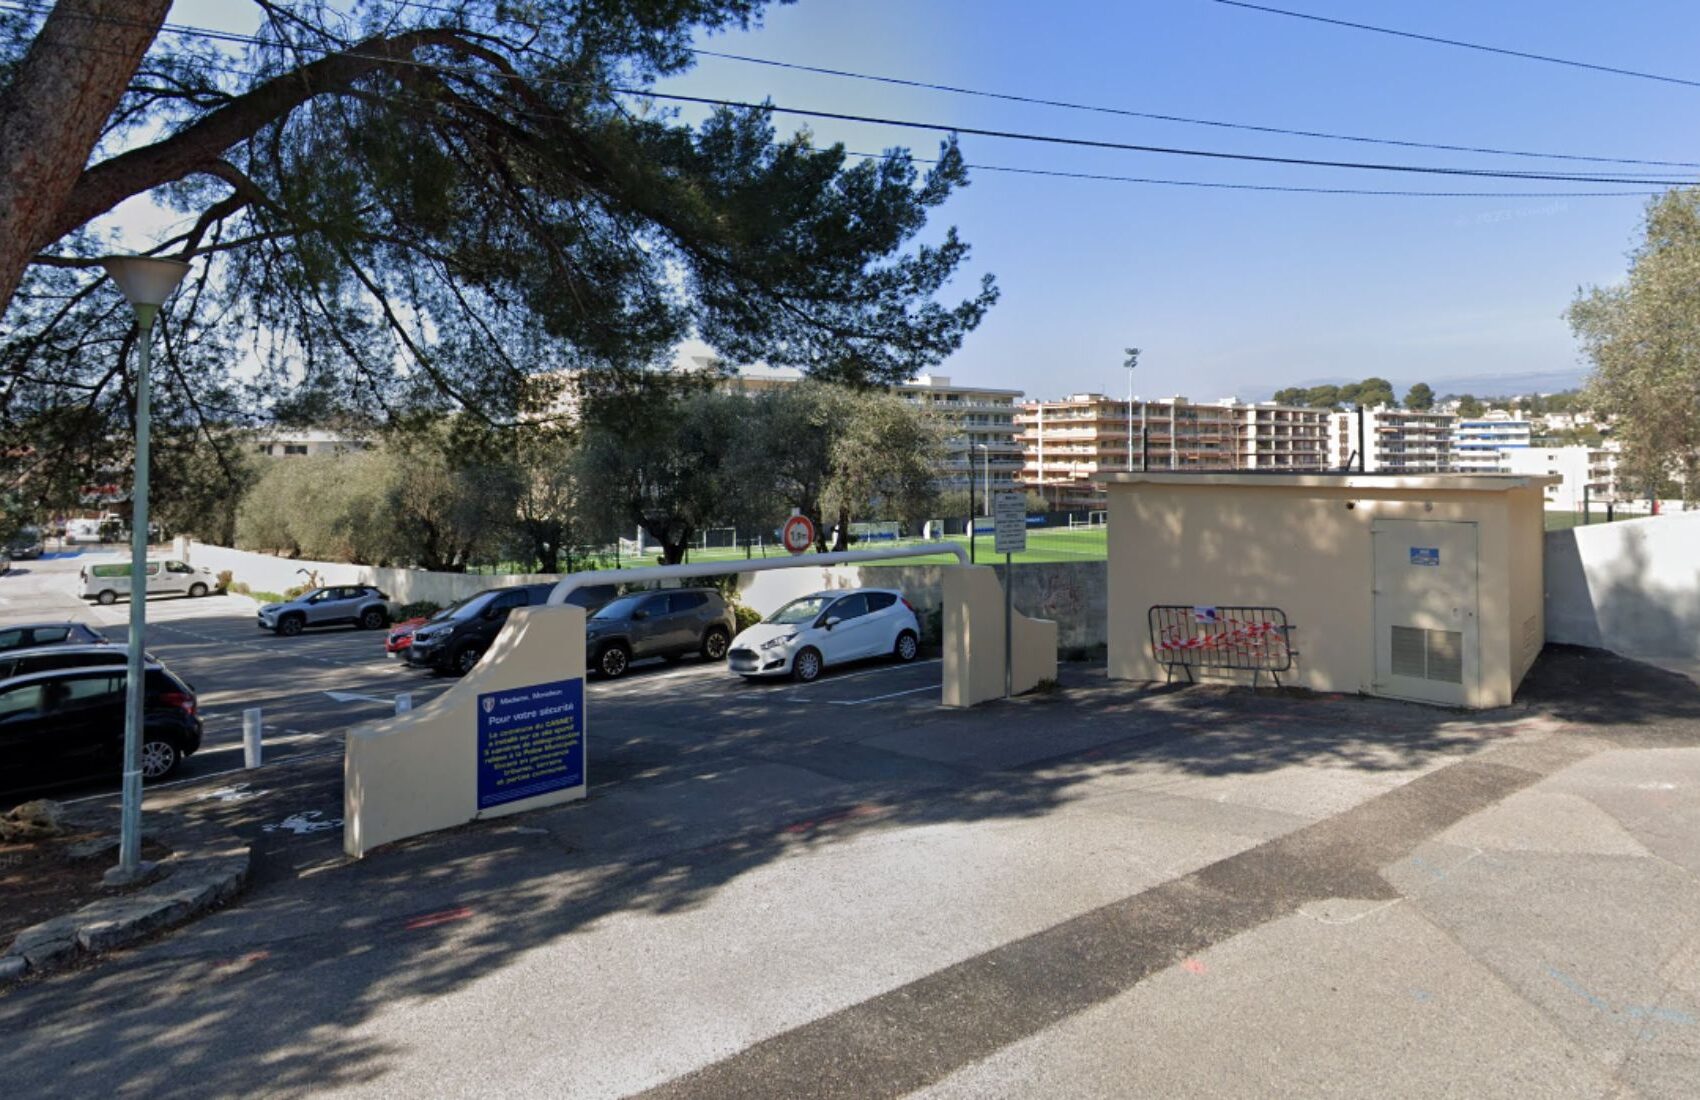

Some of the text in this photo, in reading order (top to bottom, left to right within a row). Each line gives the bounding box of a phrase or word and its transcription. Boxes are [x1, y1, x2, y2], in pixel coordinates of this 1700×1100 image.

[488, 702, 574, 726] Pour votre sécurité
